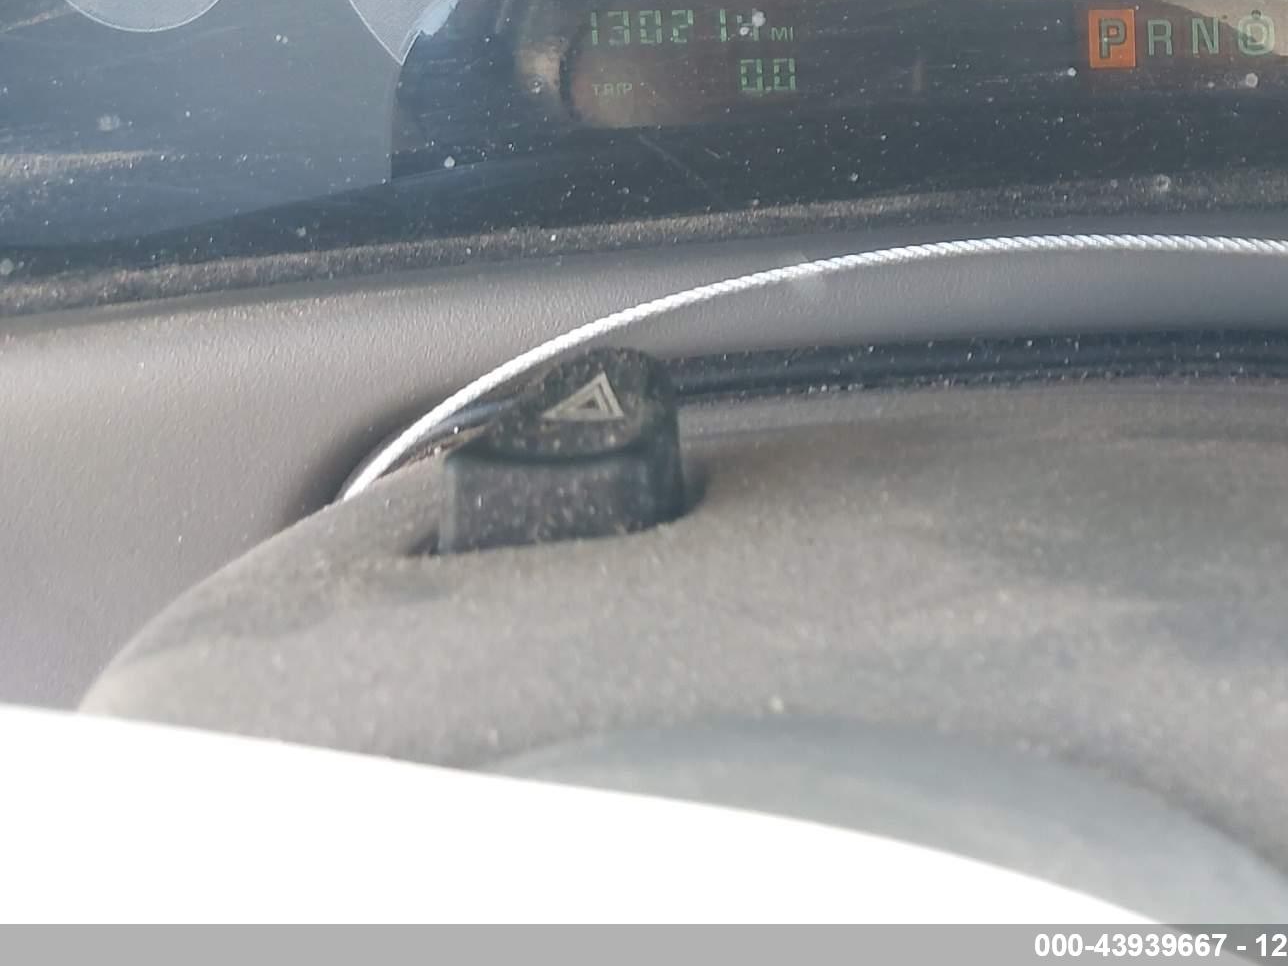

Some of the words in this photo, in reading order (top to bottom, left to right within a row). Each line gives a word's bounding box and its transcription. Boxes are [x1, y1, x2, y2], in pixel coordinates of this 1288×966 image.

[771, 25, 794, 43] MI
[1100, 17, 1126, 58] P
[1147, 19, 1173, 56] R
[1192, 17, 1220, 55] N
